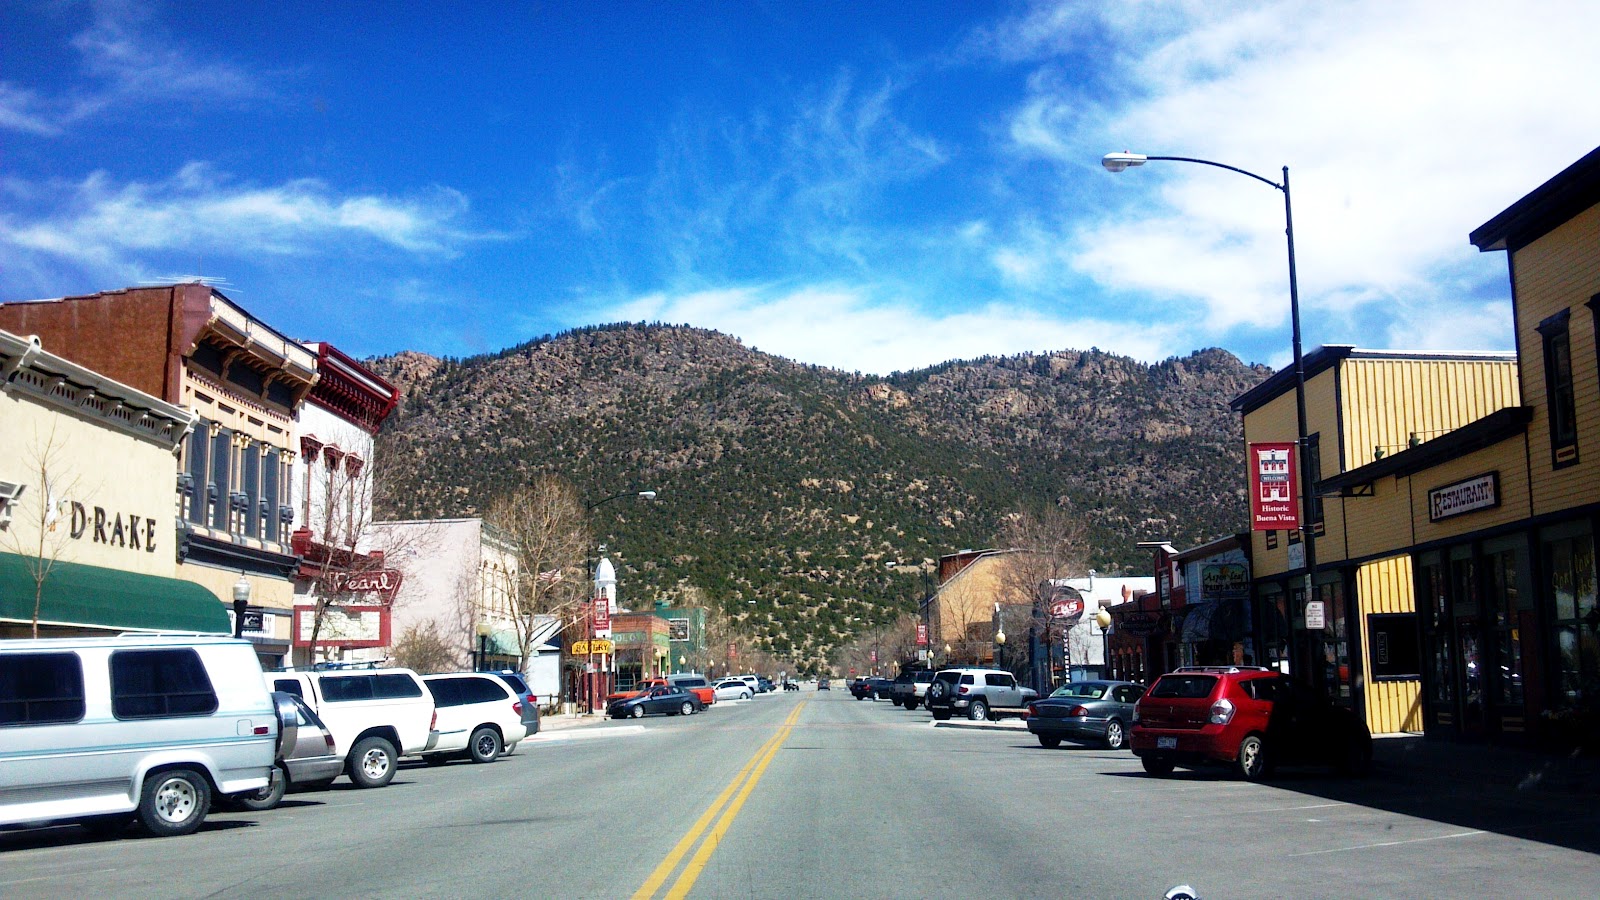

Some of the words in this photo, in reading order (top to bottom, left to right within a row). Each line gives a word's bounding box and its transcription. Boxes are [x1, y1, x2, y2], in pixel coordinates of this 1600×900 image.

[1433, 481, 1489, 517] RESTAURANT
[1256, 514, 1277, 522] Buena
[1278, 513, 1296, 521] Vista
[334, 572, 394, 592] Pearl
[575, 643, 608, 652] BAERY
